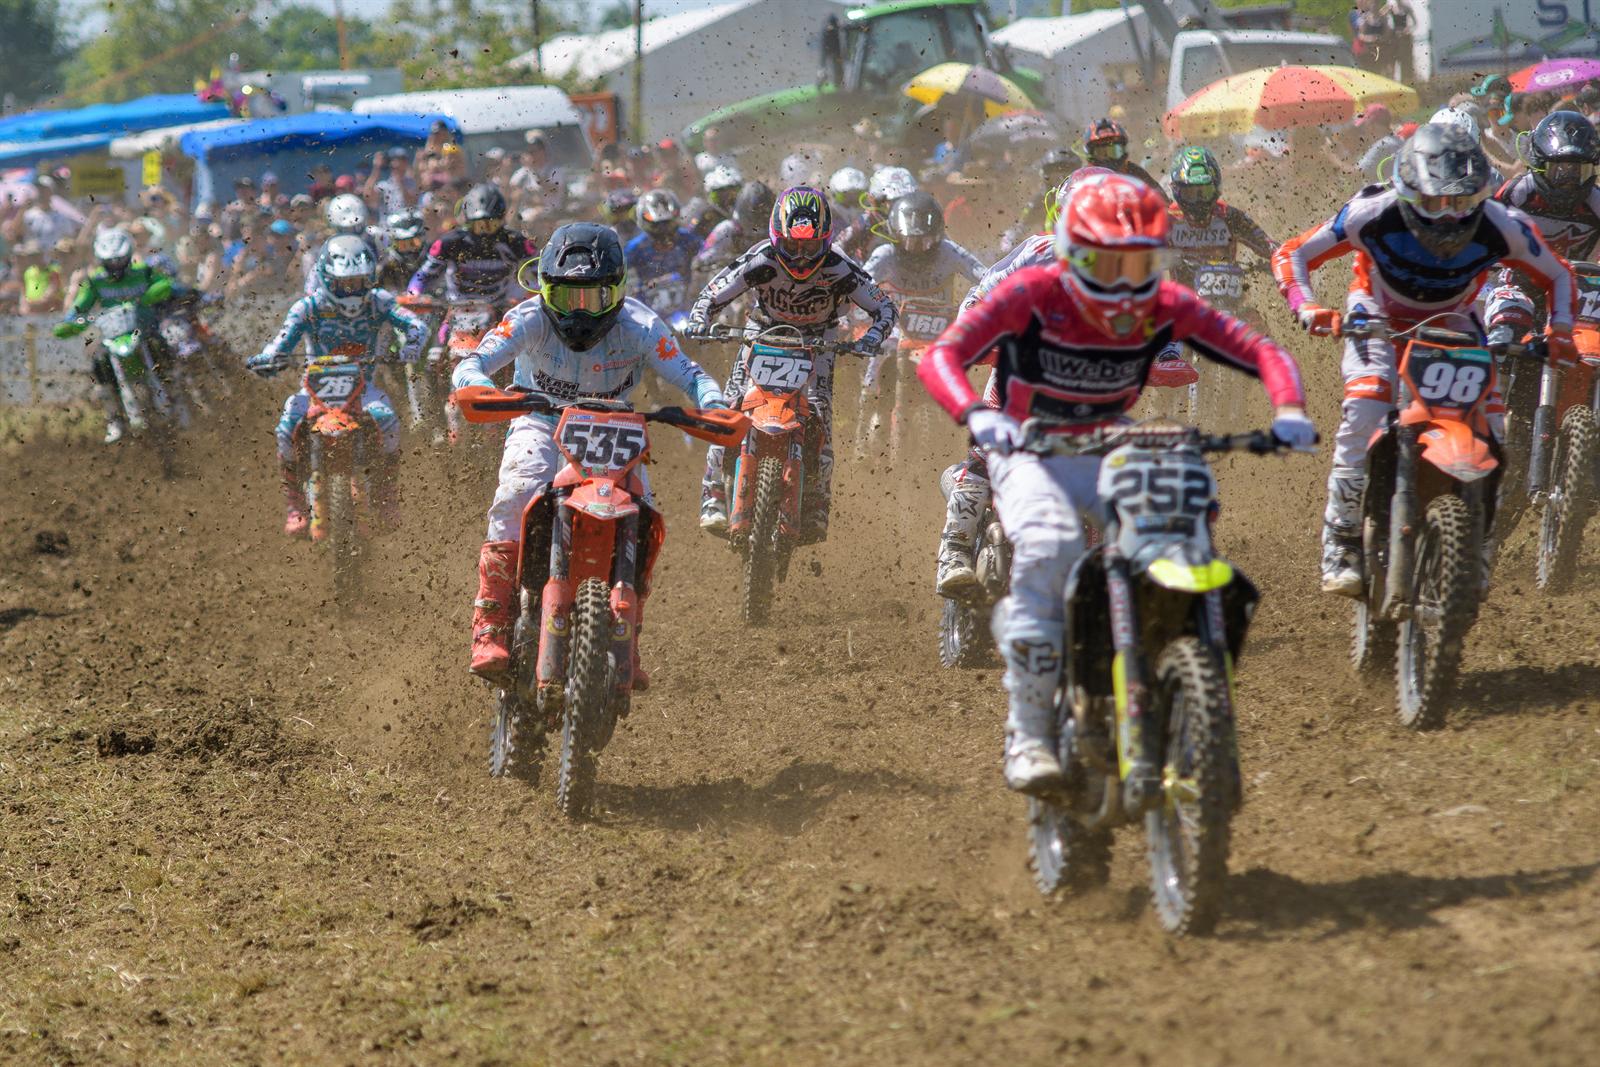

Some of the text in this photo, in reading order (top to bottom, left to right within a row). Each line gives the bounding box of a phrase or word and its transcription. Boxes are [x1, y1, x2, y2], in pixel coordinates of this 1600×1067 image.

[750, 355, 812, 389] 626
[1052, 353, 1145, 380] Weber
[1419, 362, 1486, 403] 98
[316, 375, 354, 397] 26
[562, 422, 643, 467] 535
[1112, 468, 1210, 515] 252
